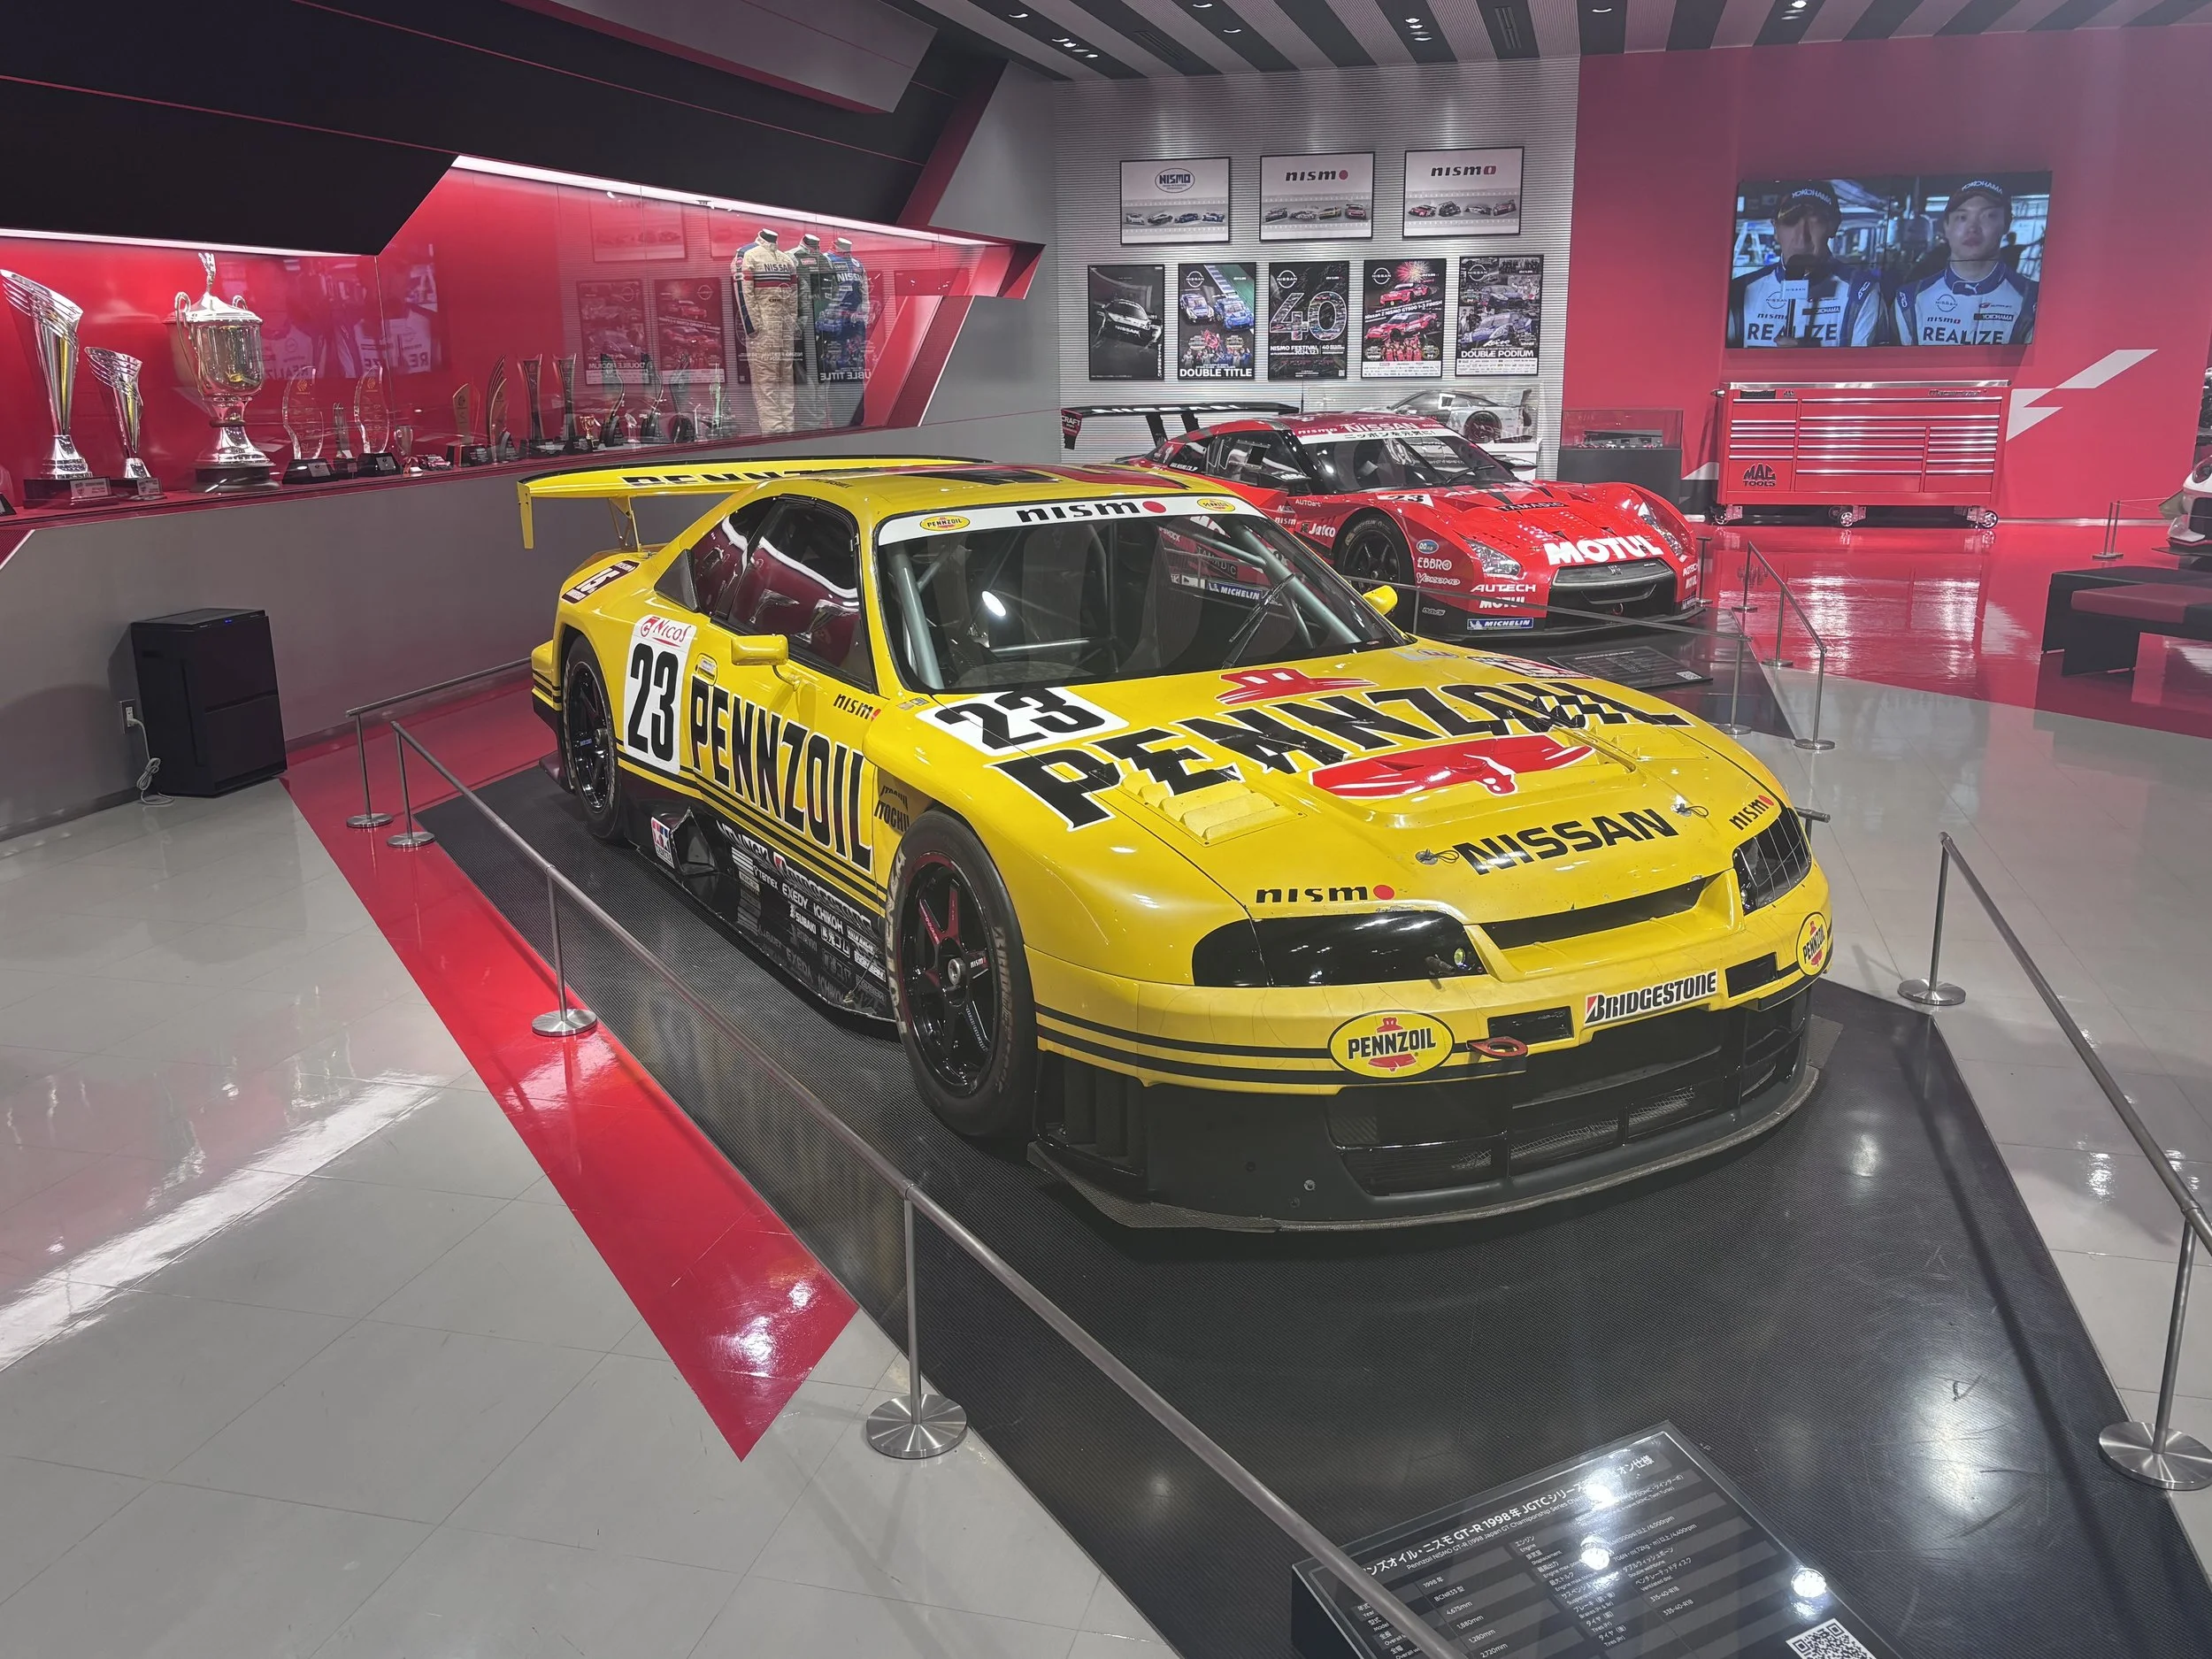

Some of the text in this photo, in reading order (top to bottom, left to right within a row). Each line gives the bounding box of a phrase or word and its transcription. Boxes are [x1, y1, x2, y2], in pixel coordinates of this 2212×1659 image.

[1159, 173, 1190, 184] NISMO
[1431, 165, 1496, 177] nismo
[1792, 188, 1832, 204] YOKOHAMA
[1962, 180, 2003, 195] YOKOHAMA
[1270, 291, 1348, 341] 40
[1923, 326, 2004, 345] REALIZE
[1179, 368, 1252, 377] DOUBLE TITLE
[1344, 422, 1418, 432] NISSAN
[1743, 464, 1776, 480] MAC
[926, 518, 964, 529] PENNZOIL
[1543, 534, 1664, 565] MOTUL
[1417, 557, 1452, 571] EBBRO
[1221, 586, 1260, 600] MICHELIN
[627, 643, 679, 762] 23
[934, 687, 1106, 750] 23
[985, 681, 1694, 832] PENNZOIL
[692, 675, 873, 874] PENNZOIL
[1452, 808, 1679, 876] NISSAN
[782, 882, 808, 910] EXEDY
[1256, 884, 1395, 903] nismo
[813, 902, 843, 934] ICHIKOH
[1802, 925, 1825, 964] PENNZOIL
[1586, 972, 1717, 1024] BRIDGESTONE
[1348, 1027, 1436, 1060] PENNZOIL
[1406, 1555, 1432, 1570] Pennzoil
[1432, 1548, 1453, 1559] NISMO
[1452, 1541, 1468, 1551] GT-R
[1467, 1535, 1484, 1545] (1998
[1483, 1528, 1502, 1539] Japan
[1548, 1501, 1568, 1511] Series
[1363, 1533, 1455, 1578] ンズオイル・ニスモ
[1451, 1522, 1484, 1541] GT-R
[1649, 1586, 1679, 1602] 315-40-R18
[1445, 1599, 1473, 1617] 4,675mm
[1372, 1622, 1390, 1632] Model
[1455, 1613, 1485, 1631] 1,880mm
[1384, 1634, 1403, 1646] Overall
[1467, 1627, 1496, 1645] 1,280mm
[1479, 1641, 1509, 1659] 2,720mm
